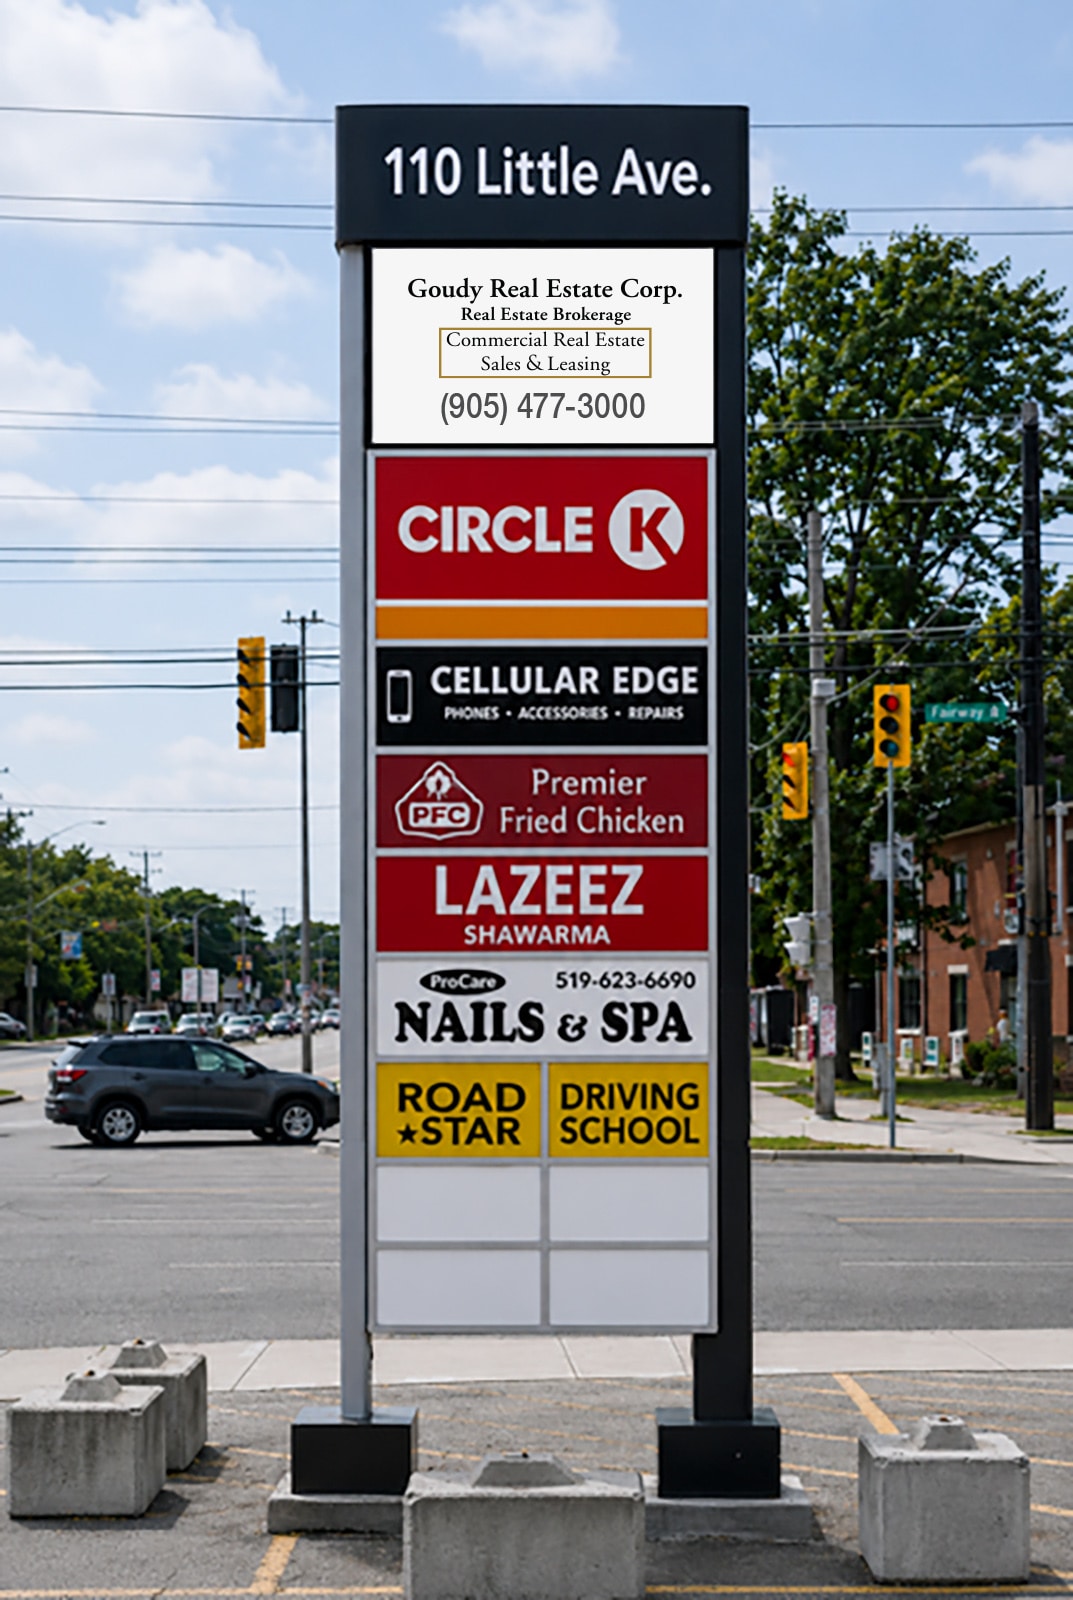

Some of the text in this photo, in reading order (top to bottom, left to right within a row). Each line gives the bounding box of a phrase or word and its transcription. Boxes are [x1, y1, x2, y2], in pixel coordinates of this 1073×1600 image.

[384, 145, 712, 195] 110 Little Ave.
[408, 278, 682, 304] Goudy Real Estate Corp.
[461, 307, 631, 325] Real Estate Brokerage
[446, 332, 645, 348] Commercial Real Estate
[481, 354, 610, 376] Sales & Leasing
[441, 392, 645, 425] (905) 477-3000
[398, 505, 677, 564] CIRCLE K
[431, 666, 698, 694] CELLULAR EDGE
[444, 706, 683, 719] PHONES ACCESSORIES REPAIRS
[532, 769, 647, 795] Premier
[412, 808, 466, 823] PFC
[500, 806, 684, 833] Fried Chicken
[436, 865, 644, 915] LAZEEZ
[464, 925, 610, 944] SHAWARMA
[431, 975, 496, 988] ProCare
[556, 972, 695, 989] 519-623-6690
[395, 1001, 692, 1042] NAILS & SPA
[398, 1083, 526, 1112] ROAD
[561, 1083, 699, 1110] DRIVING
[422, 1117, 520, 1145] STAR
[561, 1116, 699, 1144] SCHOOL
